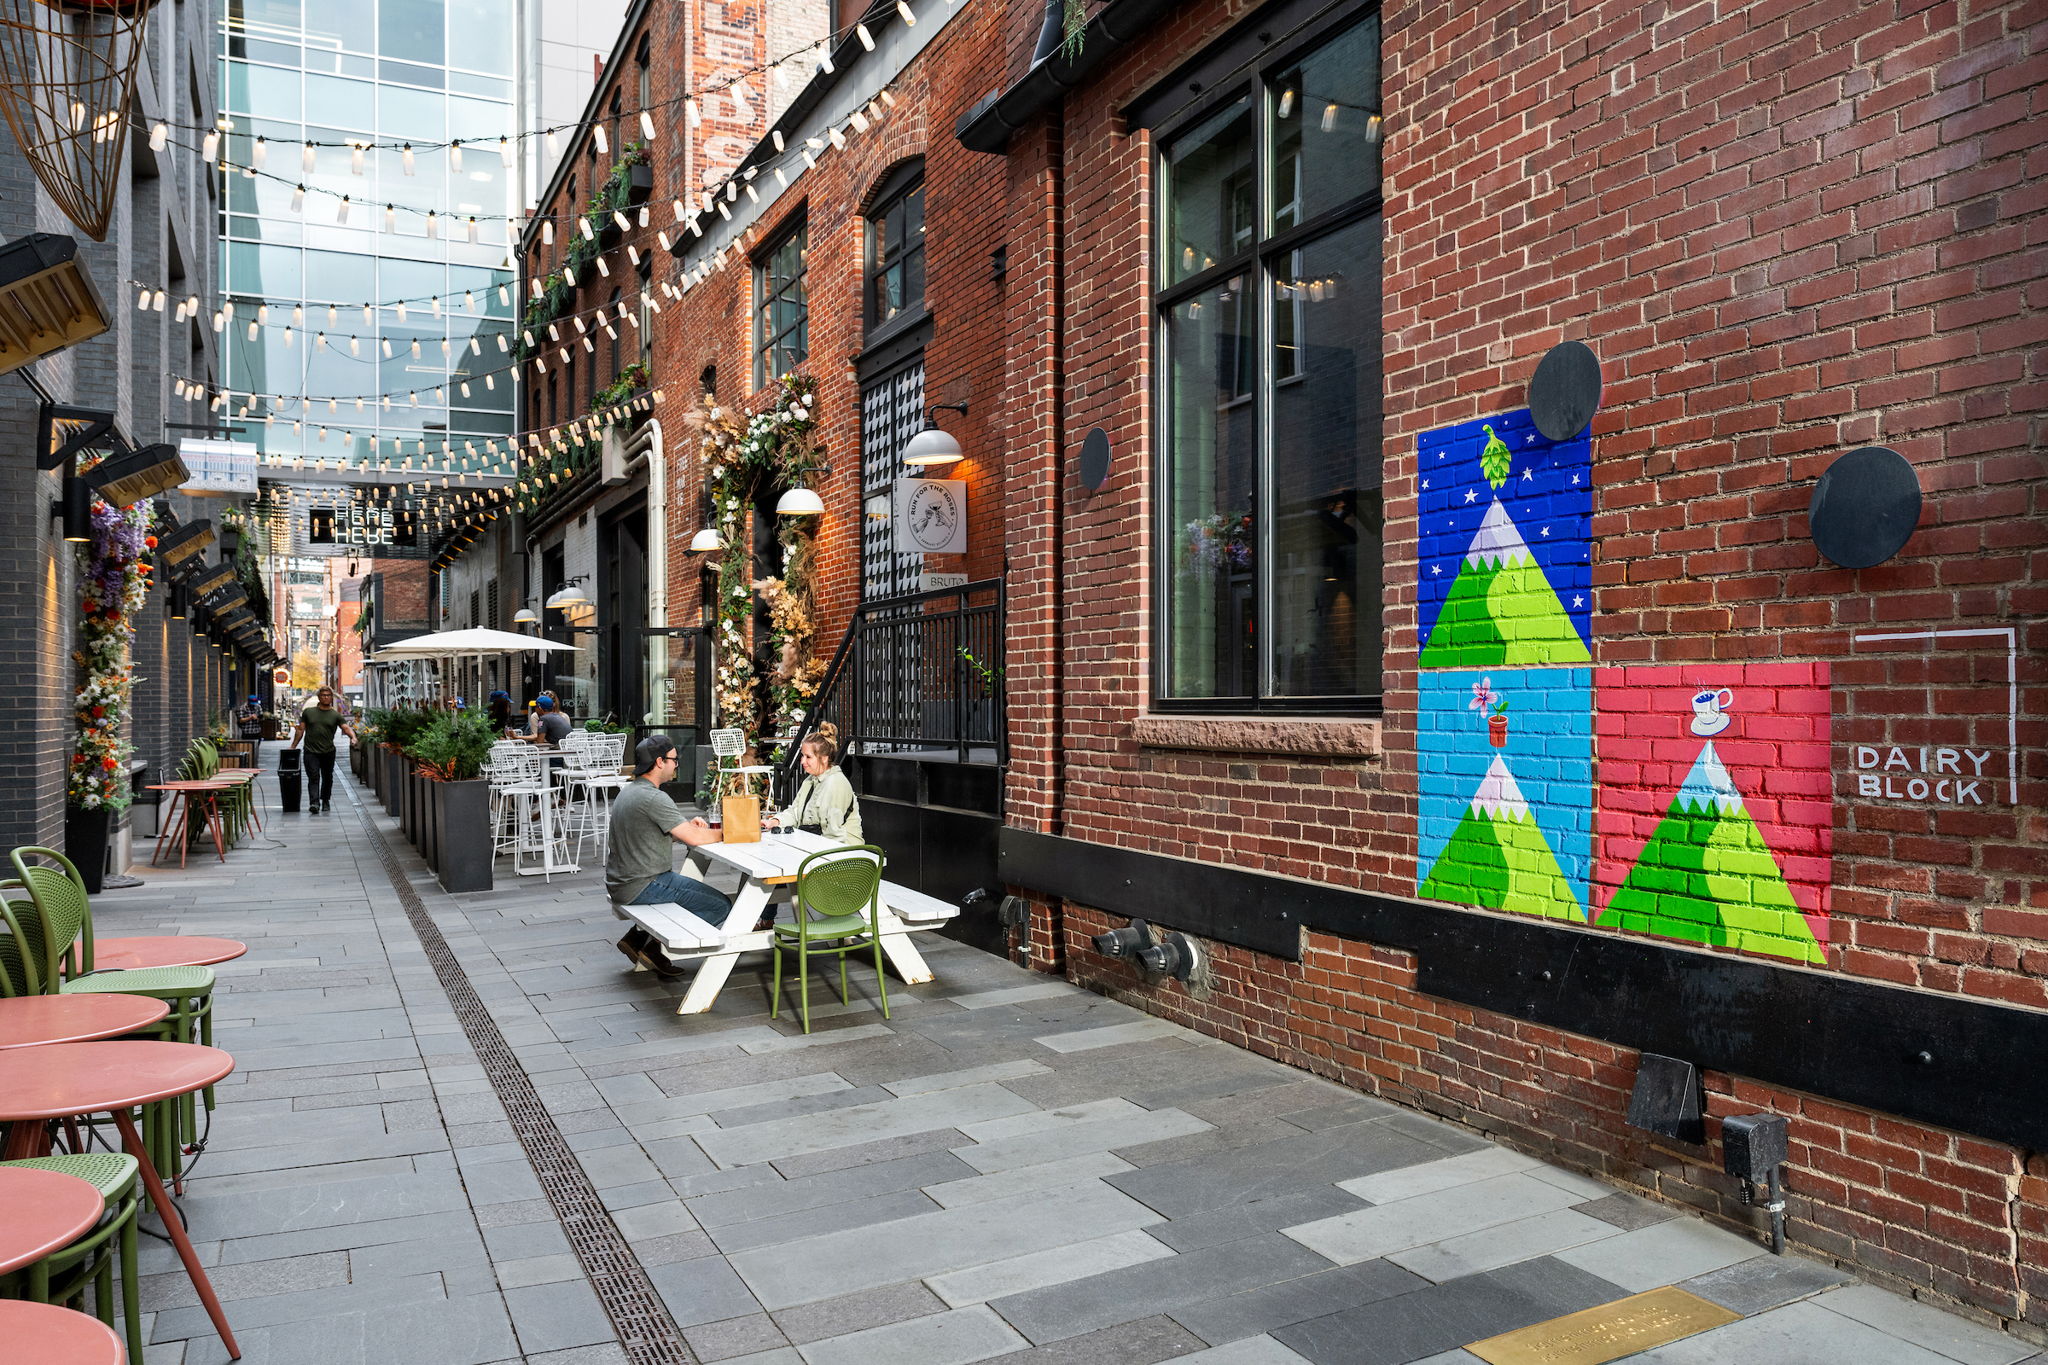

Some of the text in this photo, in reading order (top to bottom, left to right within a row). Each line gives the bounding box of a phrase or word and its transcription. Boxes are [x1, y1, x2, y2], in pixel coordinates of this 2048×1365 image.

[910, 499, 918, 516] RUN
[915, 486, 928, 499] FOR
[929, 484, 944, 494] THE
[943, 492, 955, 517] ROSES
[1857, 746, 1991, 776] DAIRY
[1858, 774, 1983, 805] BLOCK
